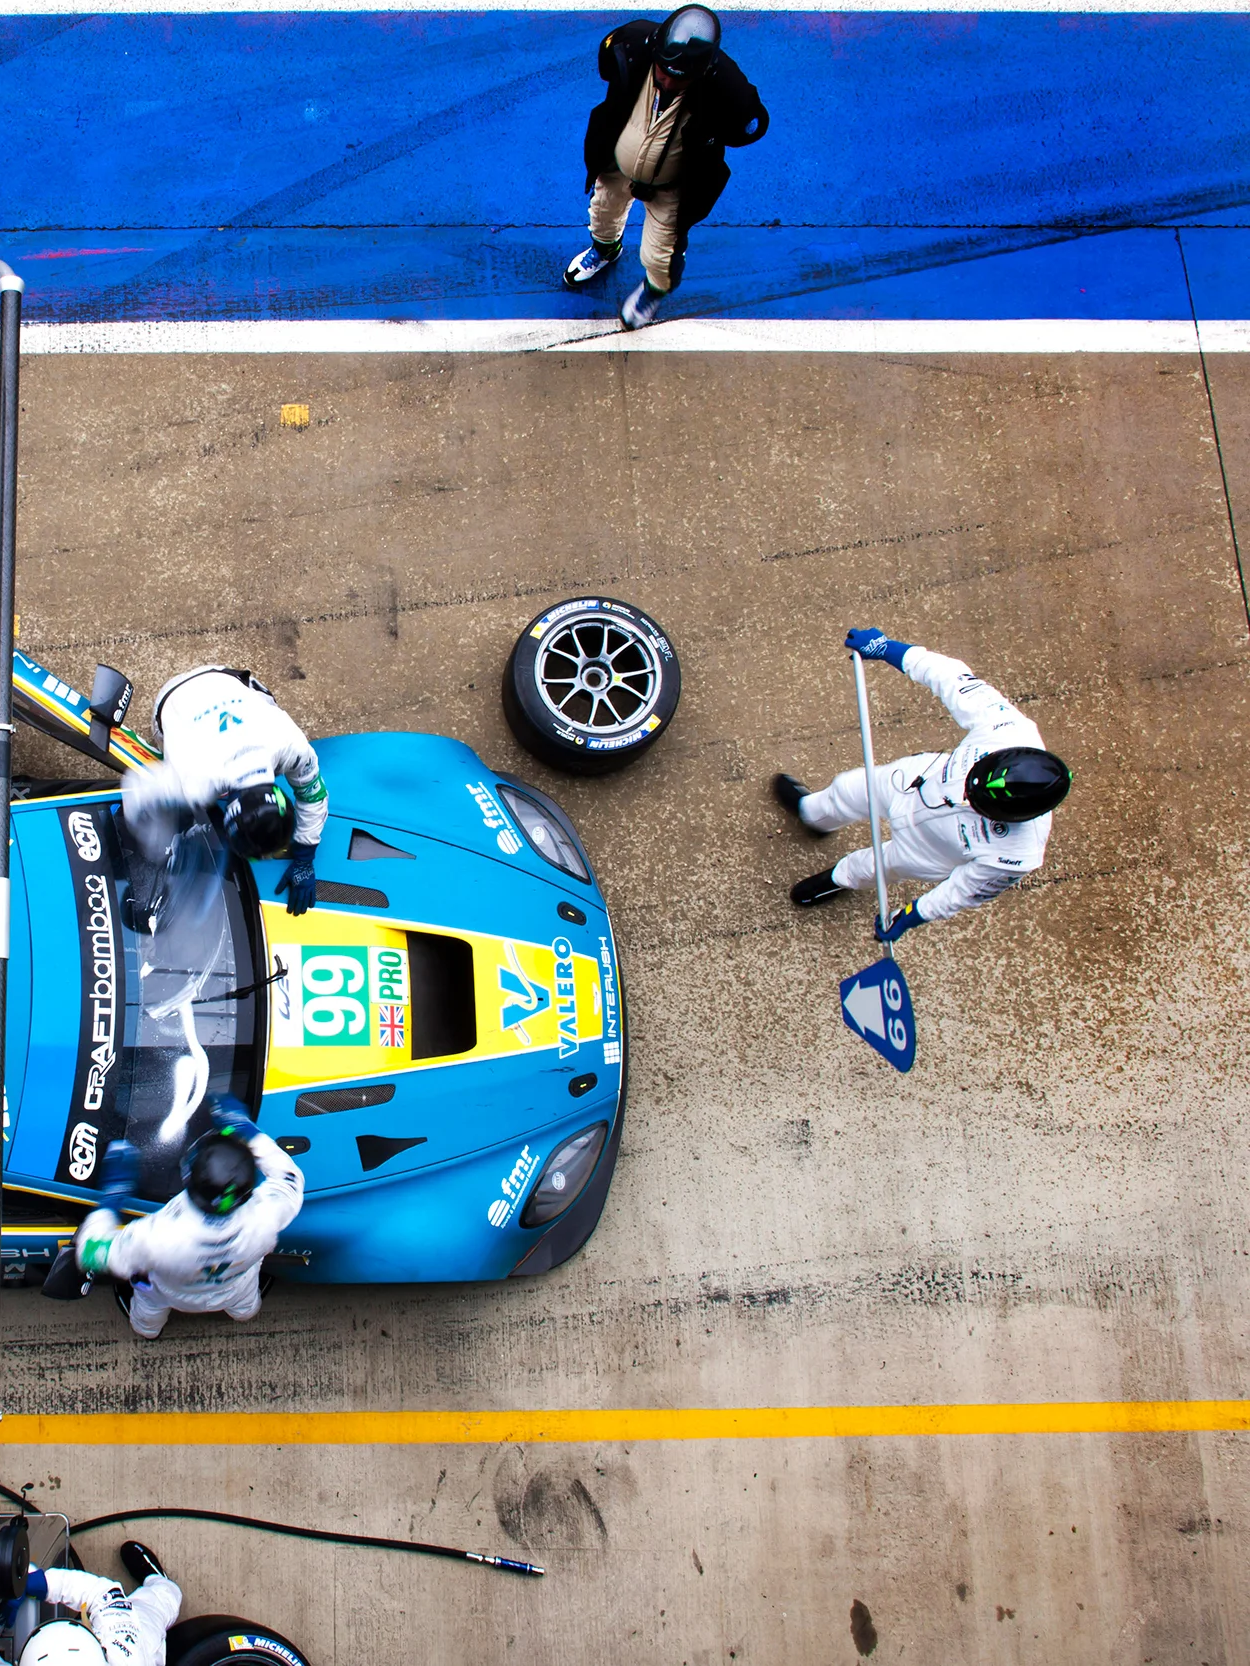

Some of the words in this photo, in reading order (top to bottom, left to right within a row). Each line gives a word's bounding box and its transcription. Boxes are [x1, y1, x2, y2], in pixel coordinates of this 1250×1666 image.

[548, 600, 598, 620] MICHELIN
[589, 730, 642, 749] MICHELIN
[68, 811, 102, 862] ecm
[302, 955, 366, 1036] 99
[378, 951, 403, 1001] PRO
[552, 936, 579, 1060] VALERO
[598, 936, 618, 1038] INTERUSH
[69, 1121, 99, 1181] ecm
[501, 1145, 533, 1200] fmr
